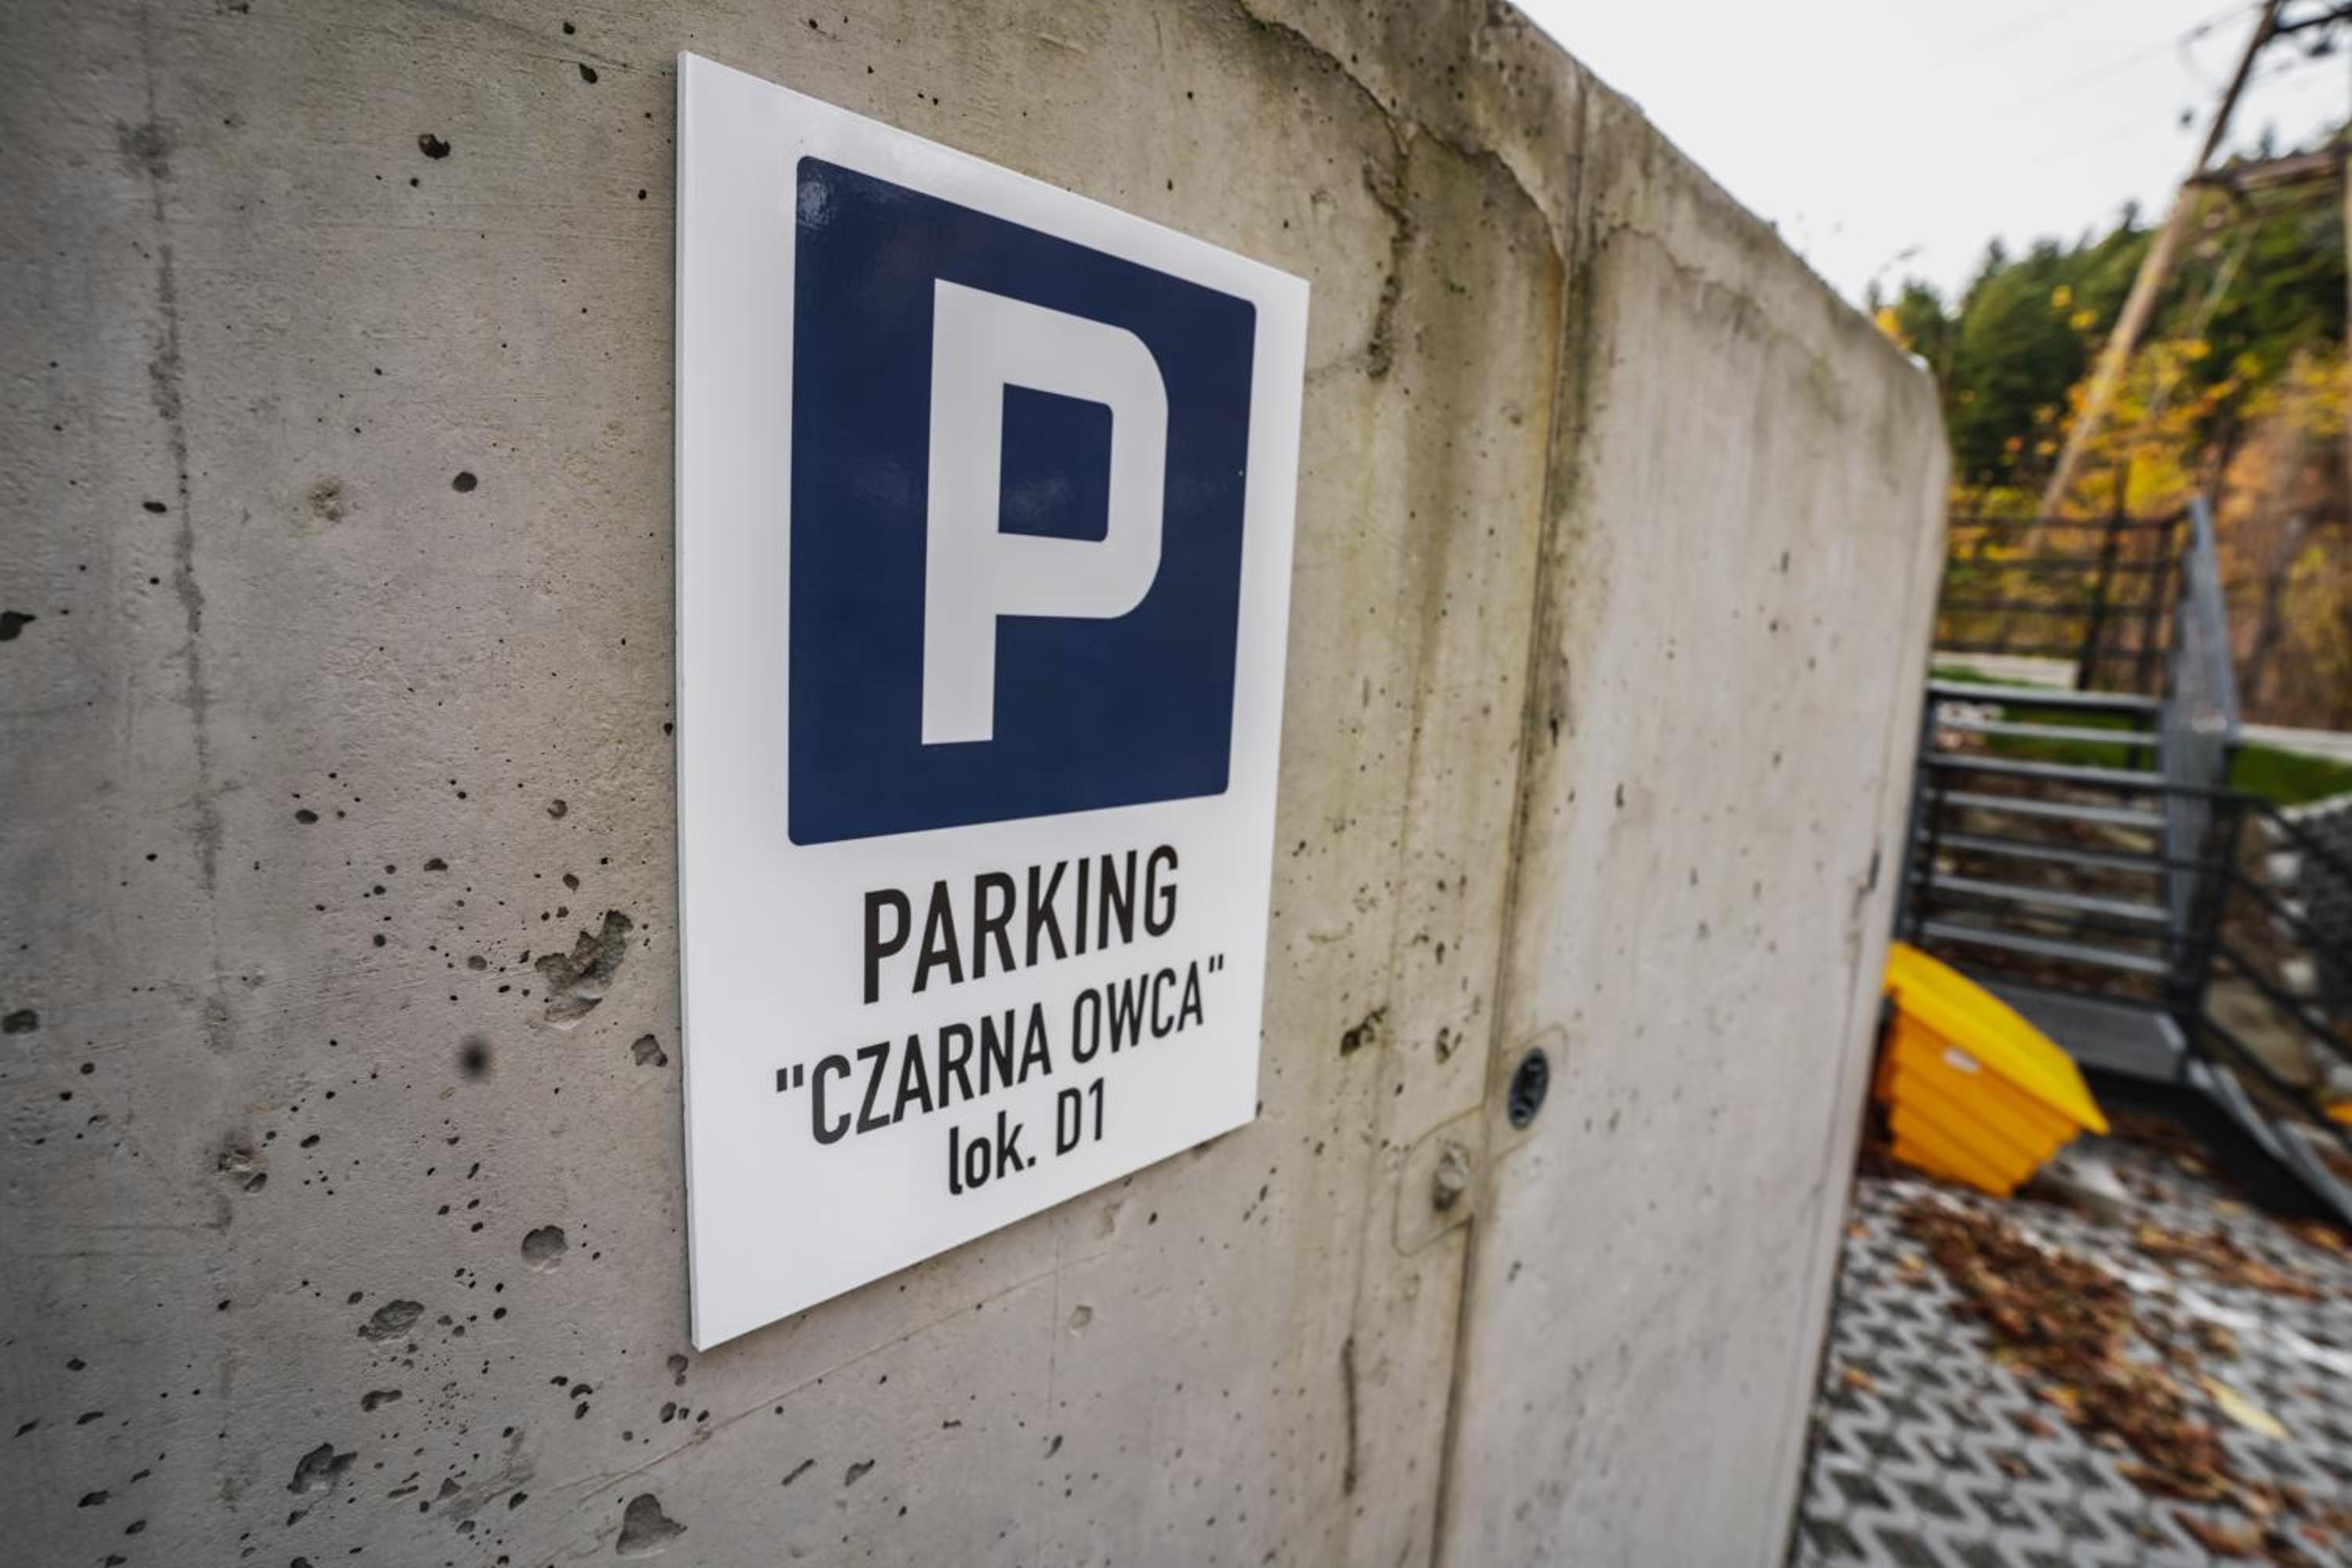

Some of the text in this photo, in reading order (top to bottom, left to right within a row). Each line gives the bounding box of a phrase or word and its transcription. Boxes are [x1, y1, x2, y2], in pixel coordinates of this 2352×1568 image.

[922, 278, 1168, 745] P
[863, 844, 1178, 1005] PARKING
[776, 953, 1225, 1145] "CZARNA OWCA"
[949, 1077, 1104, 1196] lok. D1
